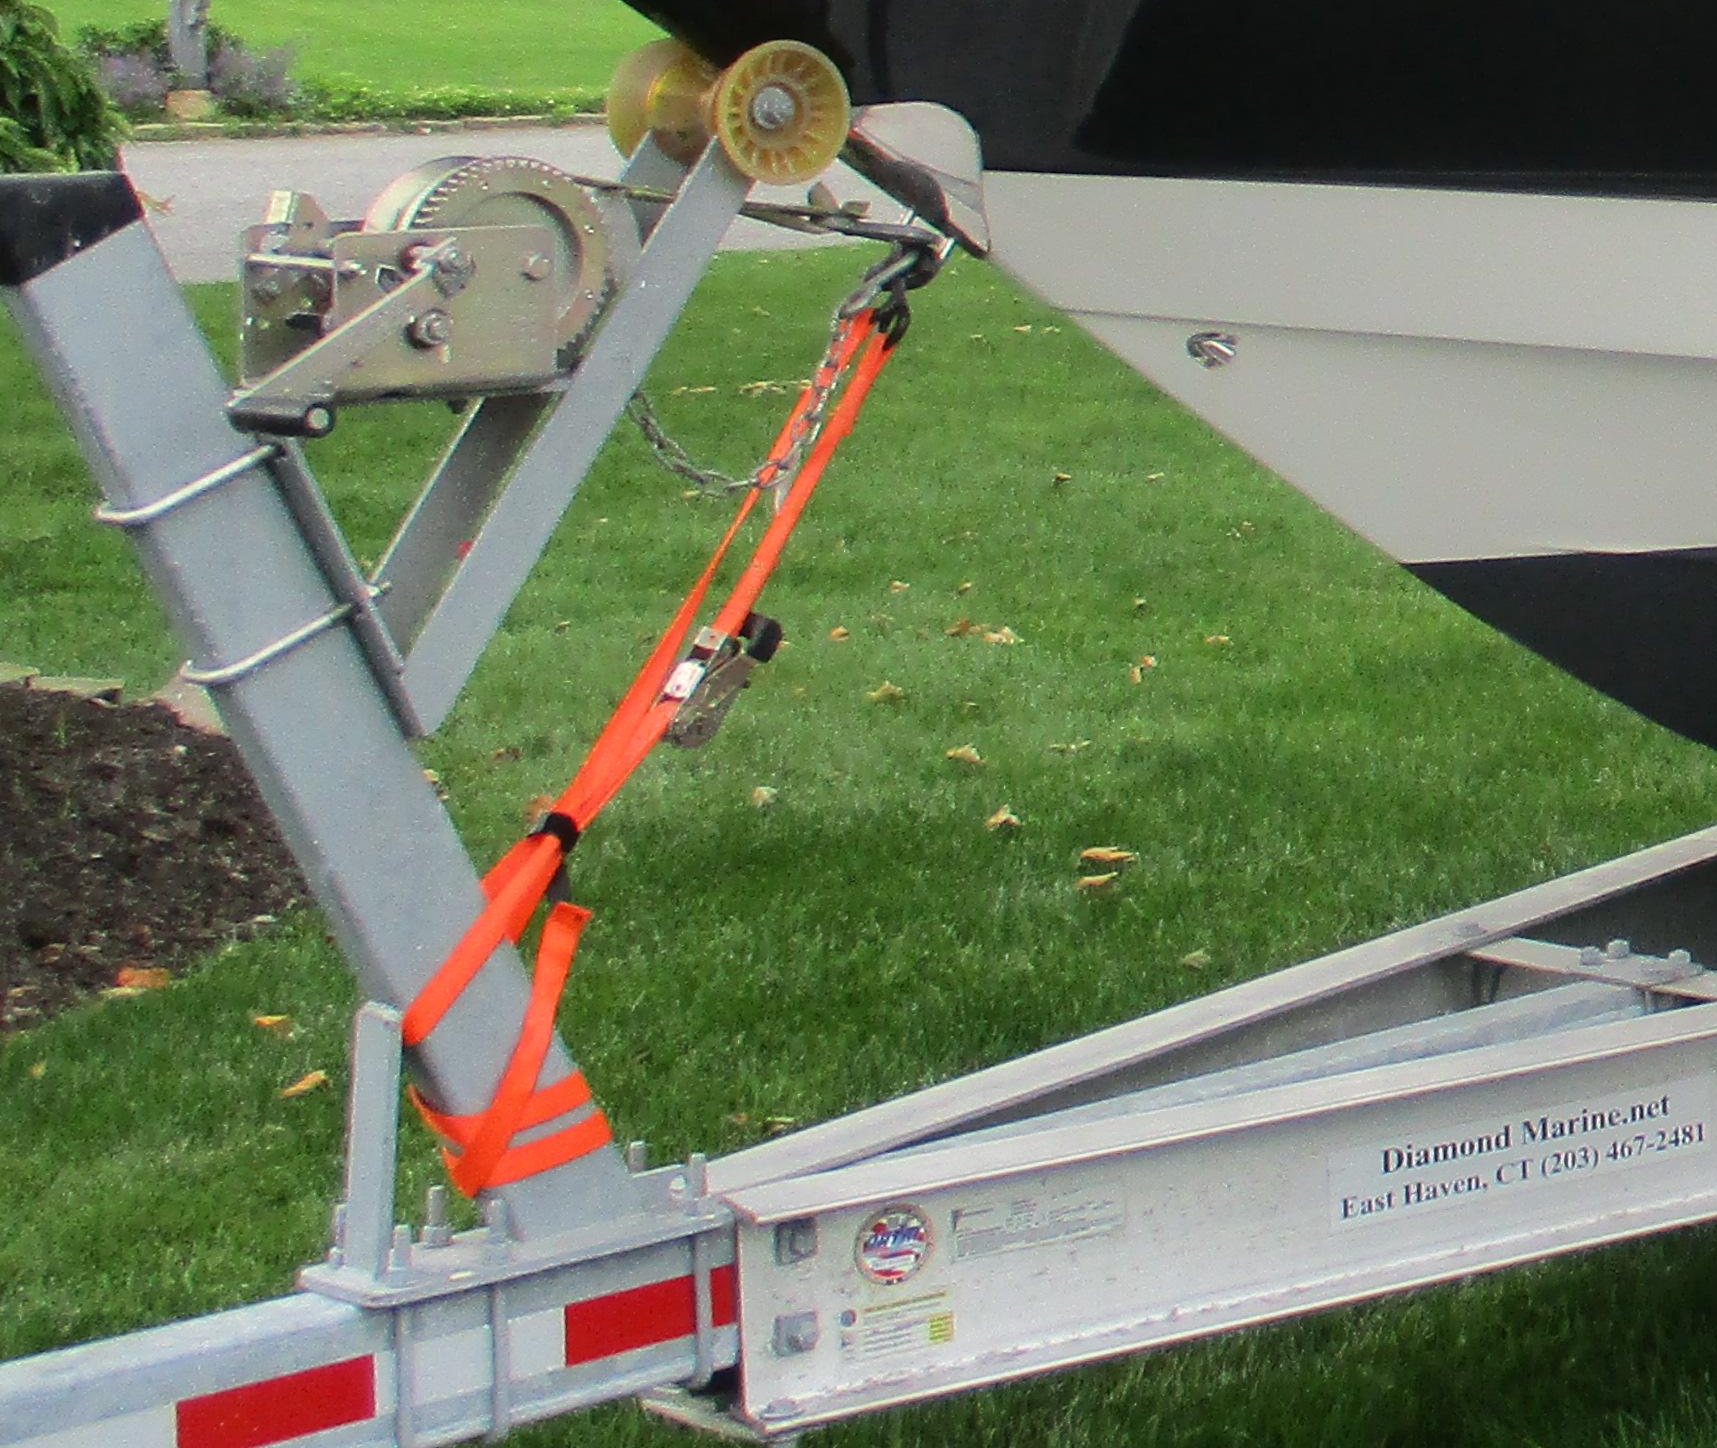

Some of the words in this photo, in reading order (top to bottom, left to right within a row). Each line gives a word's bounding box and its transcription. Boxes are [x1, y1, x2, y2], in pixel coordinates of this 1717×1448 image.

[1341, 1190, 1395, 1220] East
[1403, 1172, 1489, 1208] Haven,
[1496, 1158, 1534, 1186] CT
[1540, 1146, 1600, 1180] (203)
[1606, 1122, 1707, 1162] 467-2481
[1381, 1125, 1512, 1175] Diamond
[1522, 1094, 1671, 1145] Marine.net
